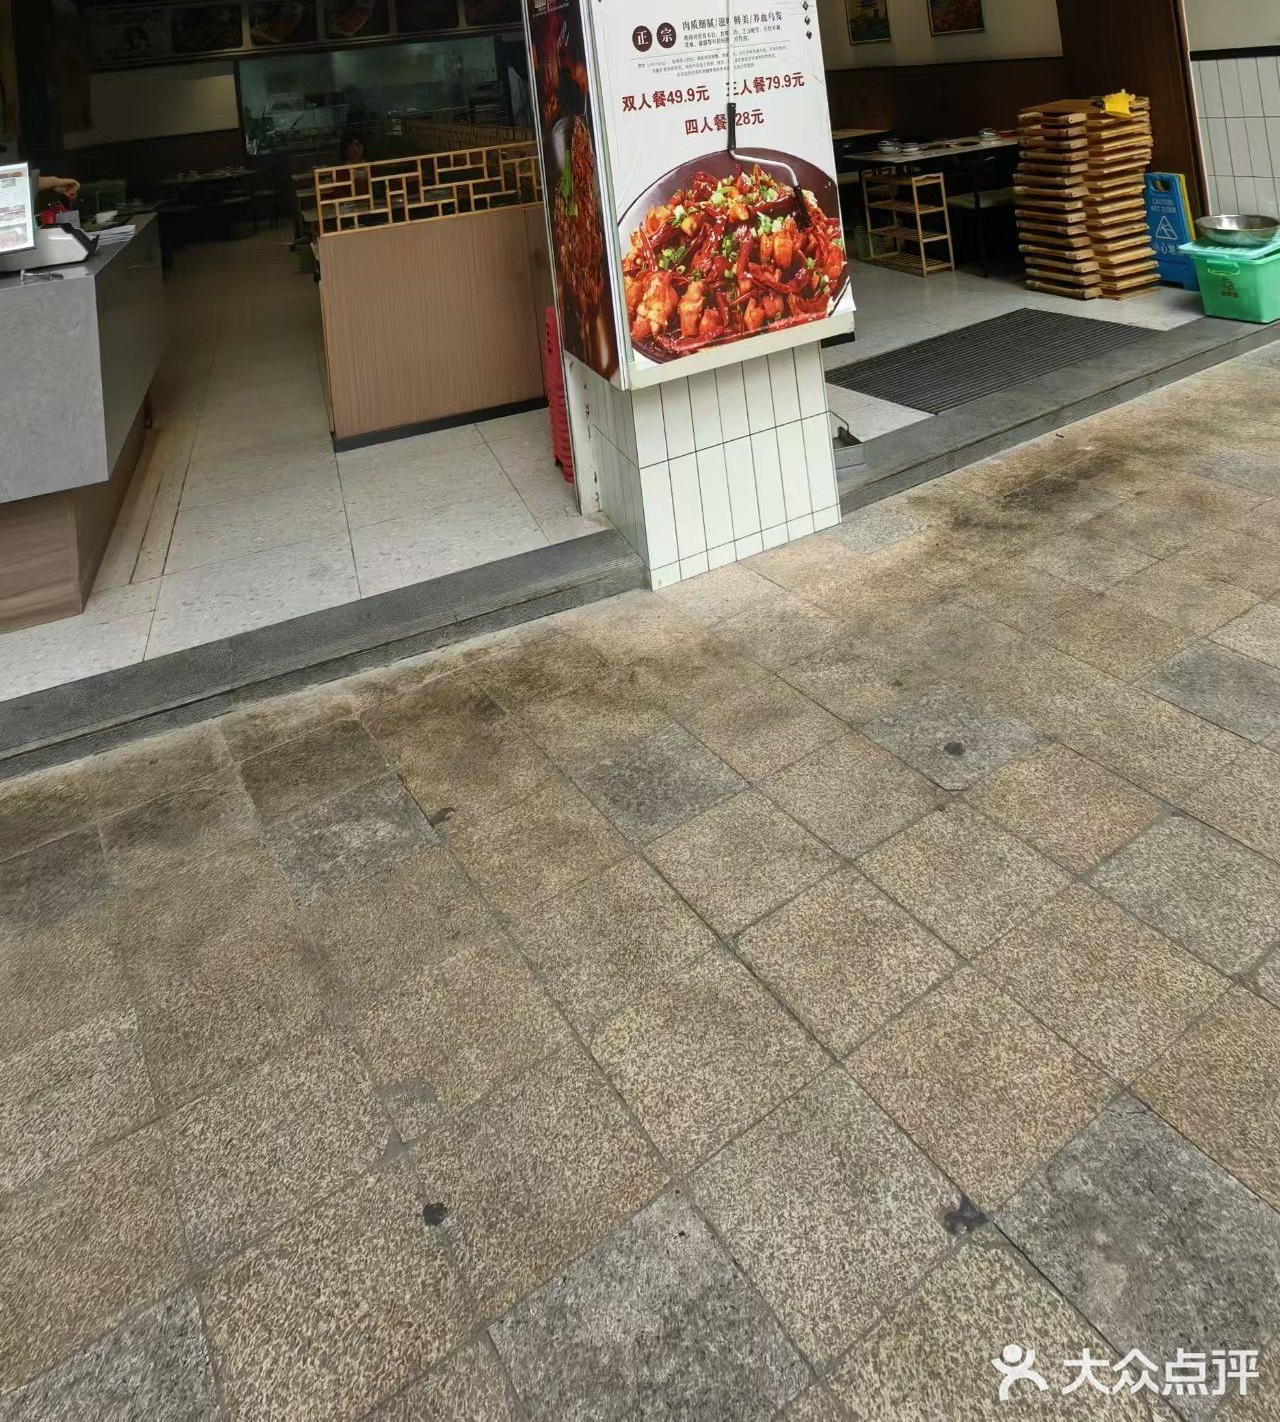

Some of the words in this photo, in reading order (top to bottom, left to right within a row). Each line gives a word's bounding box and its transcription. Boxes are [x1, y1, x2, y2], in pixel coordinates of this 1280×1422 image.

[636, 26, 673, 46] 正宗
[622, 84, 710, 113] 双人餐49.9元
[726, 71, 805, 97] 三人餐79.9元
[684, 108, 765, 136] 四人餐28元
